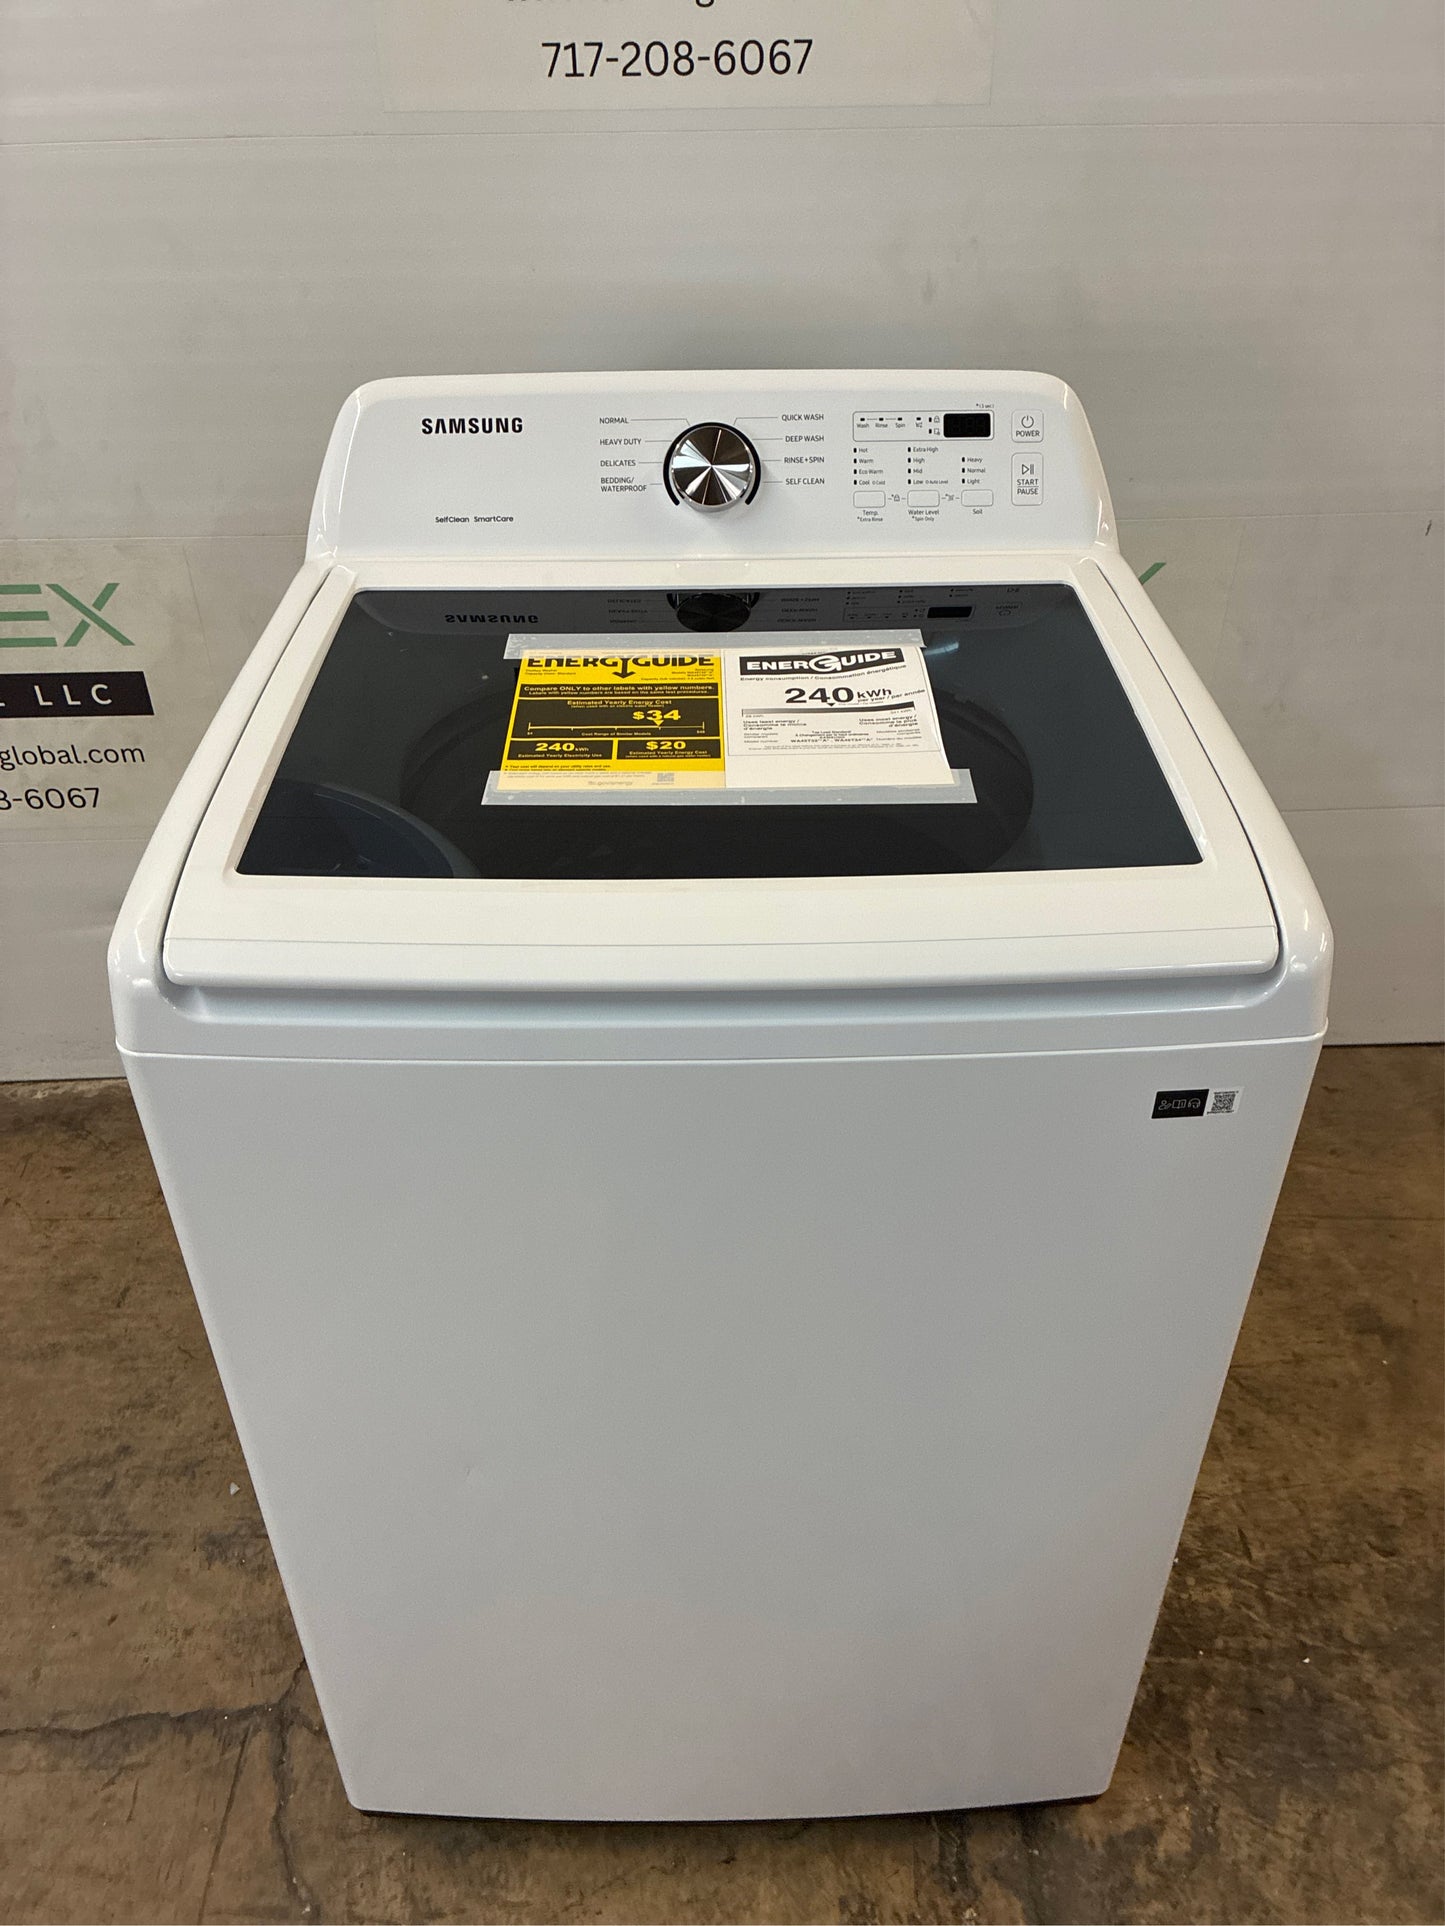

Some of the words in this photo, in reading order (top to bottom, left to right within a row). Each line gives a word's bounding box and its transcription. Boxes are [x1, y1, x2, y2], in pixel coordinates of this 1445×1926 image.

[541, 39, 813, 78] 717-208-6067
[421, 417, 523, 434] SAMSUNG
[34, 684, 112, 706] LLC
[785, 687, 854, 703] 240
[857, 688, 892, 699] kWh
[632, 709, 681, 721] $34
[535, 742, 575, 752] 240
[646, 741, 686, 750] $20
